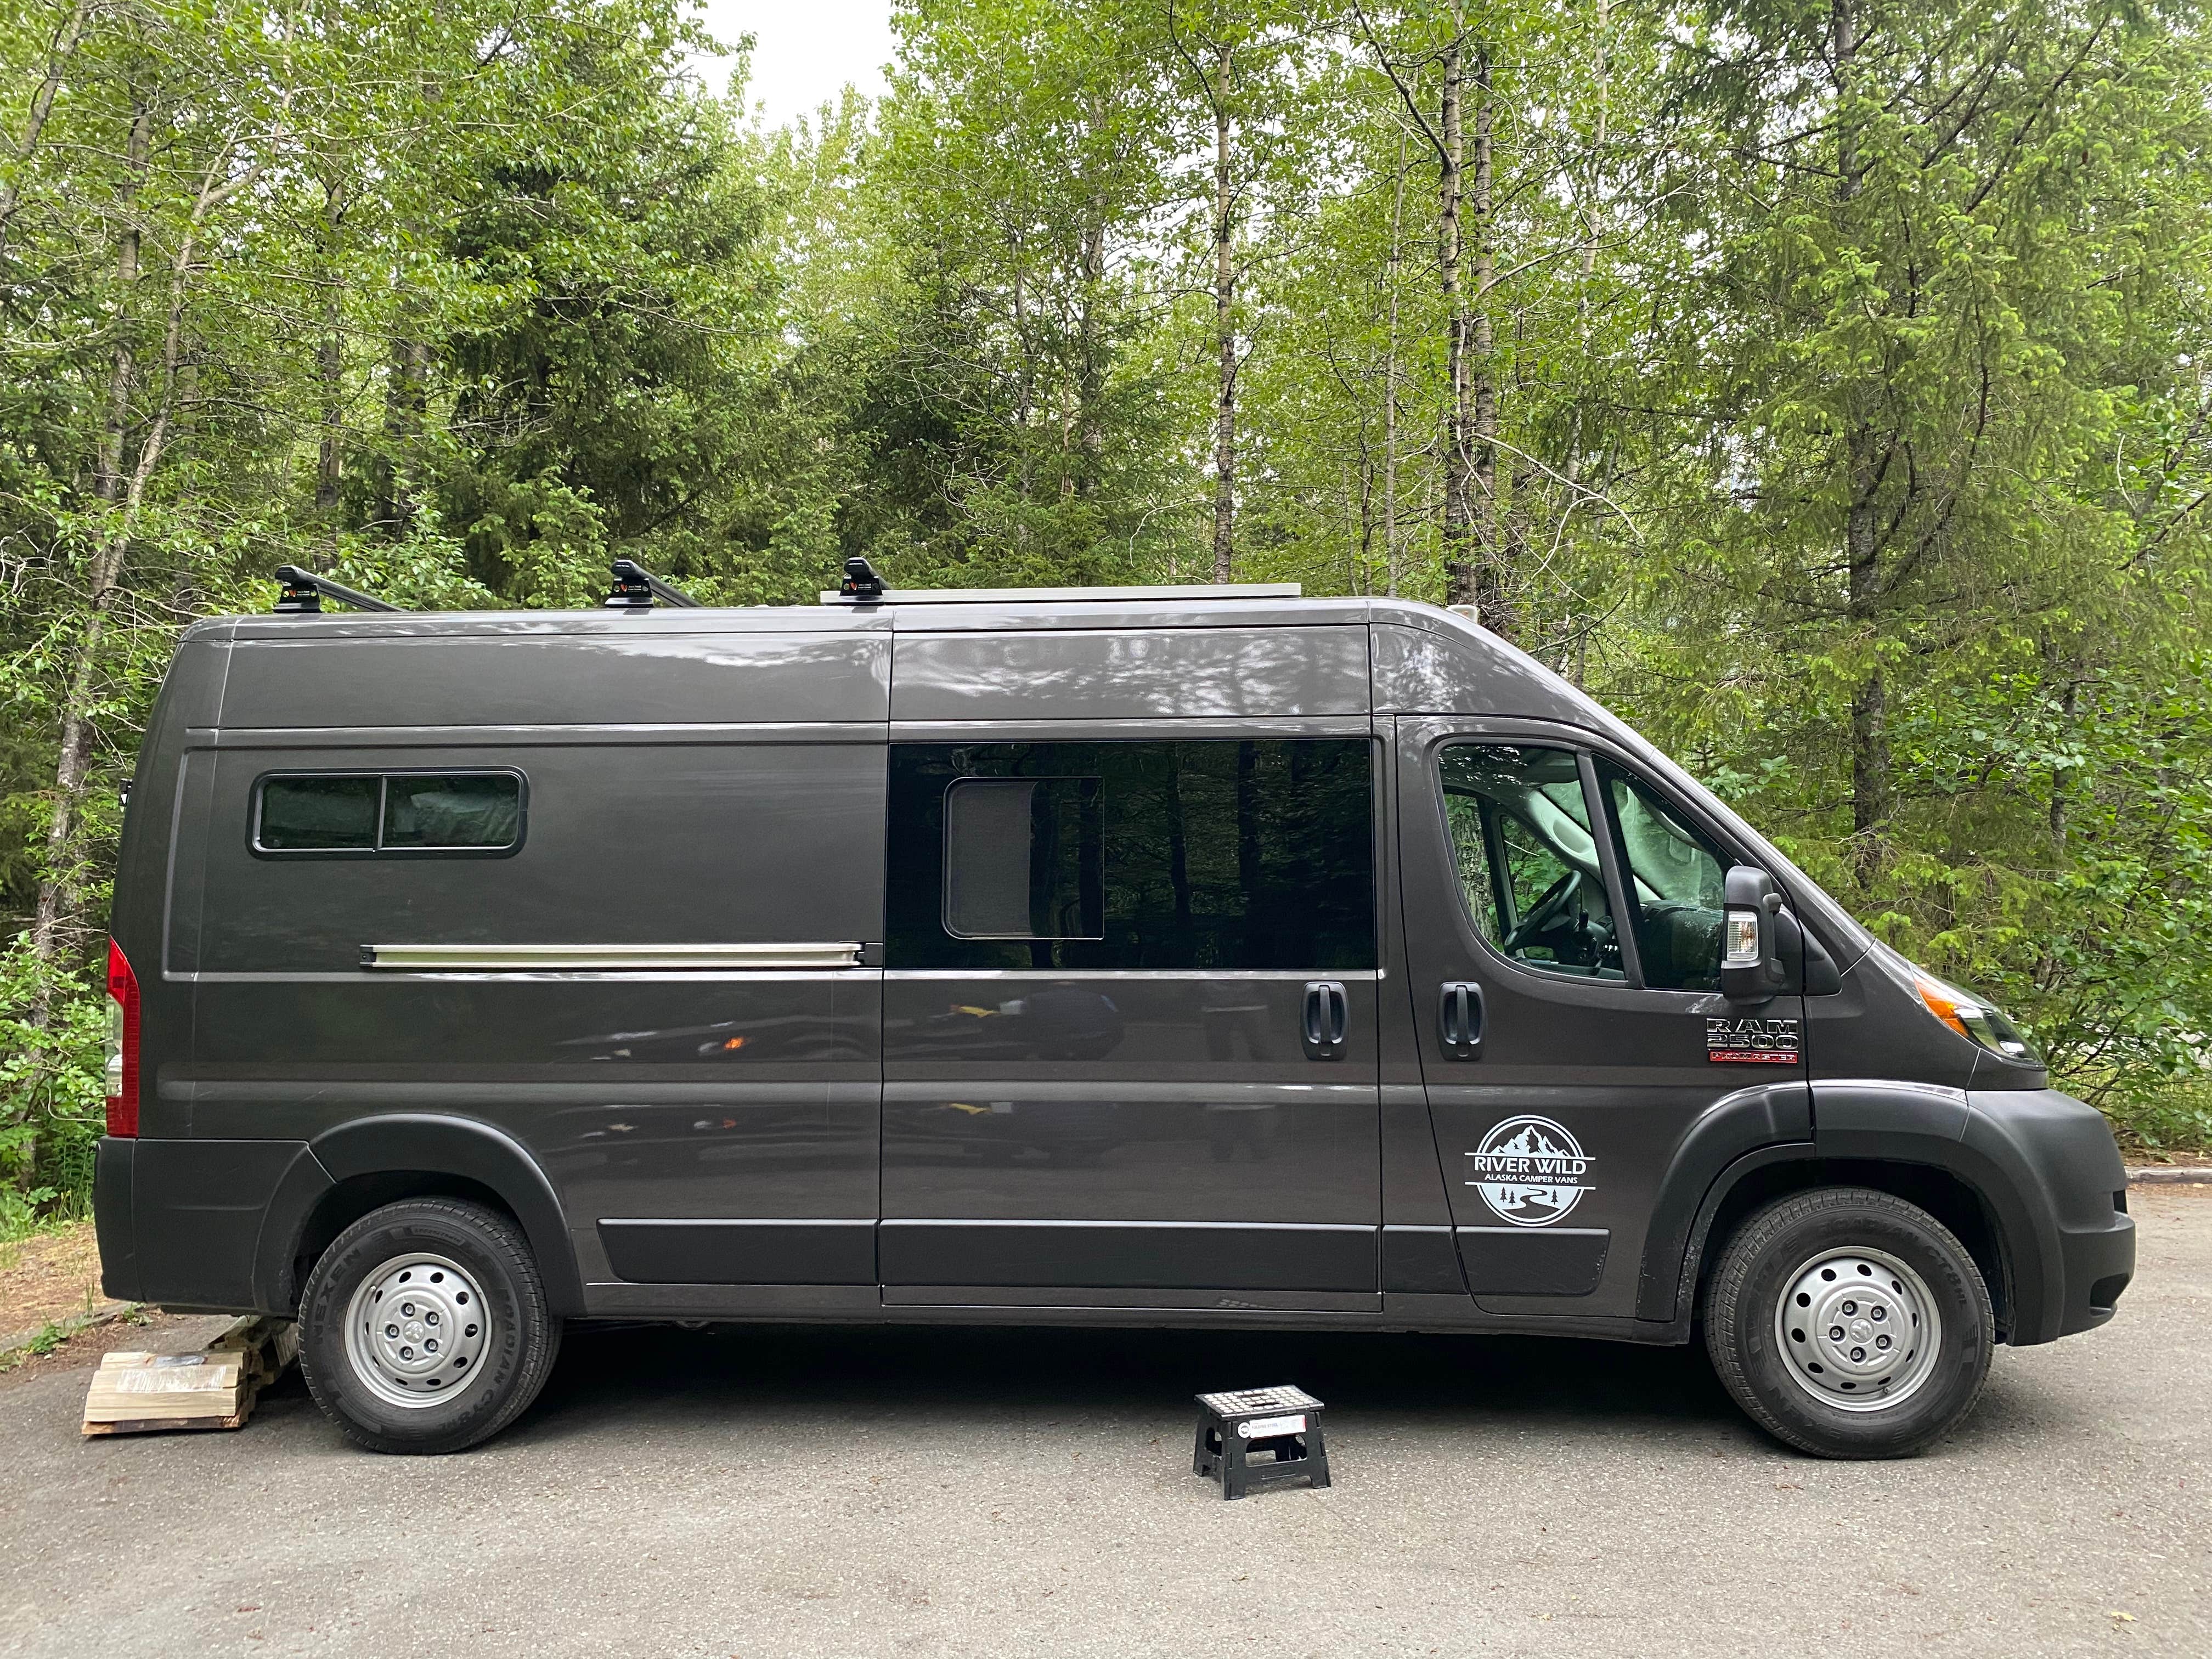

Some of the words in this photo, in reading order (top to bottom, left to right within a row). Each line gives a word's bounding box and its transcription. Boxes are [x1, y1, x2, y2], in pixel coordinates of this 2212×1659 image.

[1706, 1018, 1798, 1035] RAM
[1707, 1034, 1798, 1050] 2500
[1474, 1156, 1531, 1173] RIVER
[1534, 1159, 1587, 1175] WILD
[1484, 1173, 1518, 1182] ALASKA
[1519, 1175, 1553, 1183] CAMPER
[1554, 1176, 1578, 1184] VANS
[314, 1248, 362, 1345] NEXEN
